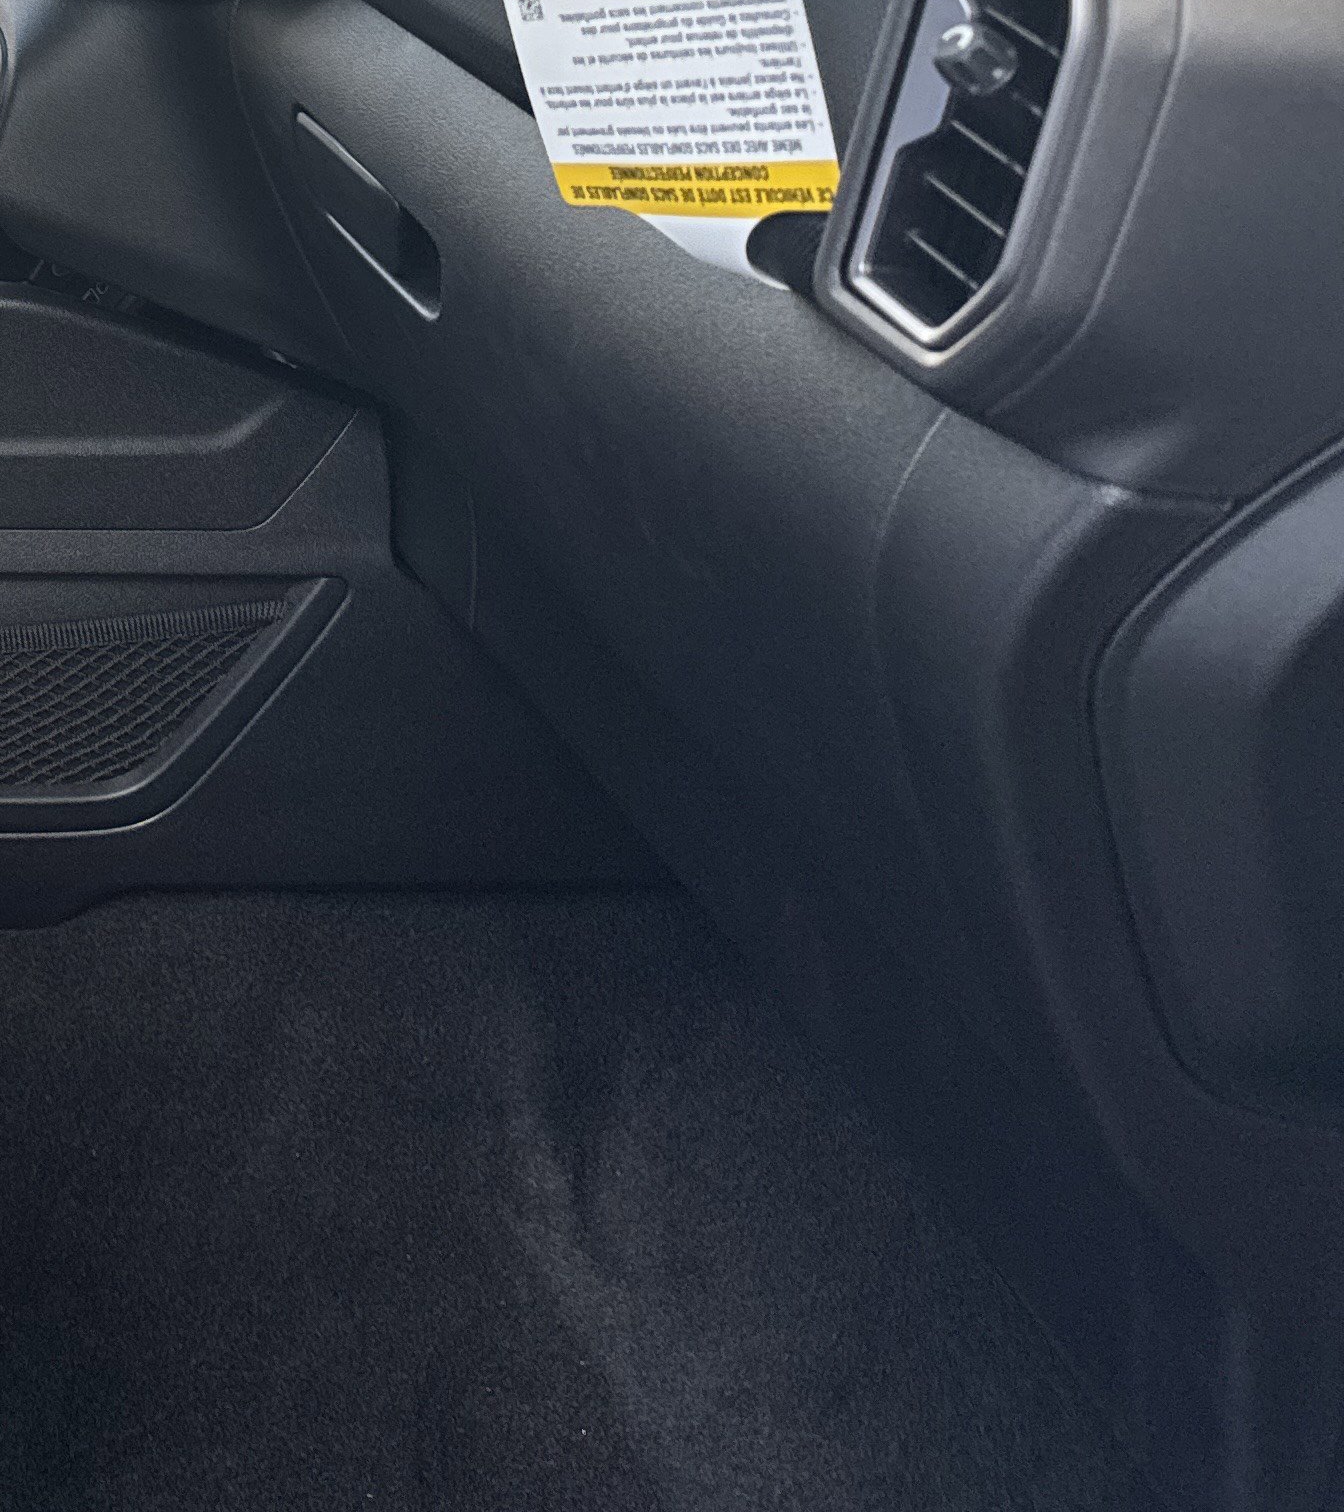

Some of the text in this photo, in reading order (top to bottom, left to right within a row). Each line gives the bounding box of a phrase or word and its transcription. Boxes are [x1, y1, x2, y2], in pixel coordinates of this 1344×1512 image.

[794, 120, 815, 133] Les
[694, 141, 720, 154] SACS
[722, 140, 741, 153] DES
[743, 140, 768, 153] AVEC
[694, 165, 769, 181] CONCEPTION
[570, 185, 585, 199] DE
[586, 186, 649, 201] GONFLABLES
[650, 187, 678, 202] SACS
[680, 188, 696, 202] DE
[730, 188, 751, 203] EST
